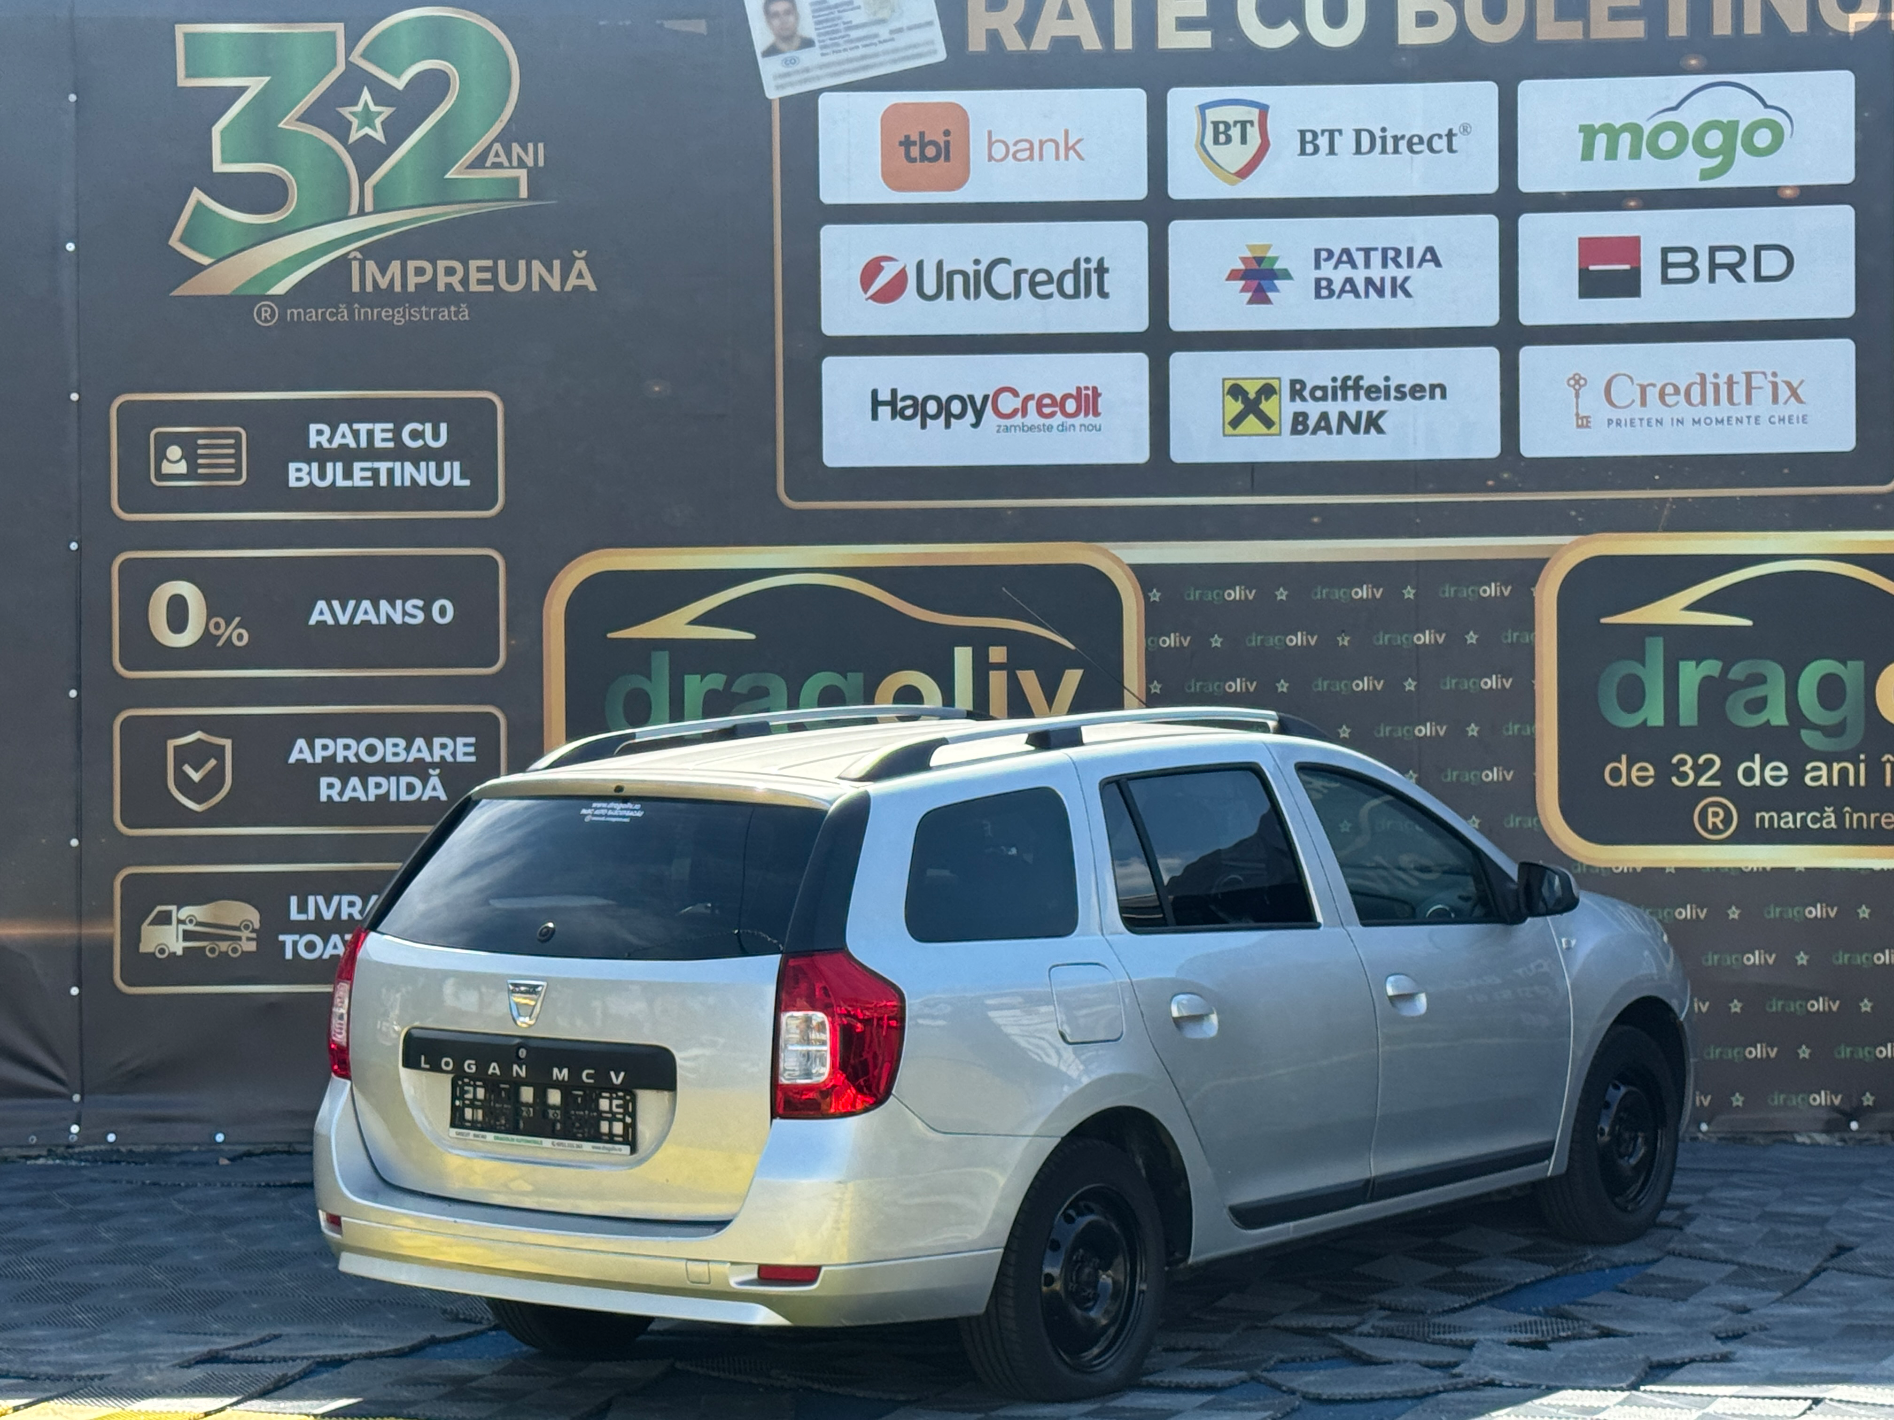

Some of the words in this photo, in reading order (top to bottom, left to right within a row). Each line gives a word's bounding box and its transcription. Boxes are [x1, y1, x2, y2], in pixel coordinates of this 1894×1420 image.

[1211, 119, 1255, 146] BT
[1297, 128, 1343, 157] BT
[484, 142, 545, 168] ANI
[898, 129, 952, 165] tbi
[986, 128, 1085, 164] bank
[1578, 114, 1786, 182] mogo
[348, 250, 597, 293] ÎMPREUNĂ
[1313, 245, 1443, 271] PATRIA
[1659, 243, 1795, 286] BRD
[915, 255, 1110, 302] UniCredit
[1313, 275, 1413, 300] BANK
[286, 303, 349, 322] marcă
[353, 302, 470, 325] înregistrată
[1289, 374, 1447, 402] Raiffeisen
[1603, 370, 1807, 410] CreditFix
[870, 385, 1102, 430] HappyCredit
[1607, 416, 1664, 429] PRIETEN
[1670, 416, 1685, 428] IN
[1692, 414, 1762, 427] MOMENTE
[1767, 413, 1809, 426] CHEIE
[308, 422, 394, 449] RATE
[401, 422, 448, 449] CU
[995, 421, 1053, 434] zambeste
[1056, 420, 1076, 433] din
[1079, 422, 1102, 433] nou
[1289, 409, 1389, 436] BANK
[287, 461, 470, 489] BULETINUL
[1184, 585, 1256, 604] dragoliv
[1311, 584, 1384, 603] dragoliv
[1438, 582, 1512, 601] dragoliv
[308, 599, 424, 626] AVANS
[431, 599, 454, 625] 0
[1245, 631, 1318, 650] dragoliv
[1373, 629, 1446, 648] dragoliv
[1184, 678, 1257, 695] dragoliv
[1312, 676, 1384, 694] dragoliv
[1439, 674, 1513, 693] dragoliv
[1374, 722, 1447, 741] dragoliv
[287, 737, 476, 764] APROBARE
[1440, 766, 1514, 785] dragoliv
[1603, 753, 1655, 787] de
[1670, 753, 1722, 787] 32
[1737, 753, 1789, 787] de
[1804, 753, 1866, 787] ani
[319, 768, 447, 802] RAPIDĂ
[1755, 806, 1837, 830] marcă
[1764, 902, 1838, 922] dragoliv
[1702, 949, 1776, 968] dragoliv
[1766, 996, 1840, 1015] dragoliv
[1703, 1043, 1778, 1062] dragoliv
[420, 1054, 527, 1079] LOGAN
[552, 1066, 626, 1086] MCV
[1767, 1090, 1842, 1109] dragoliv
